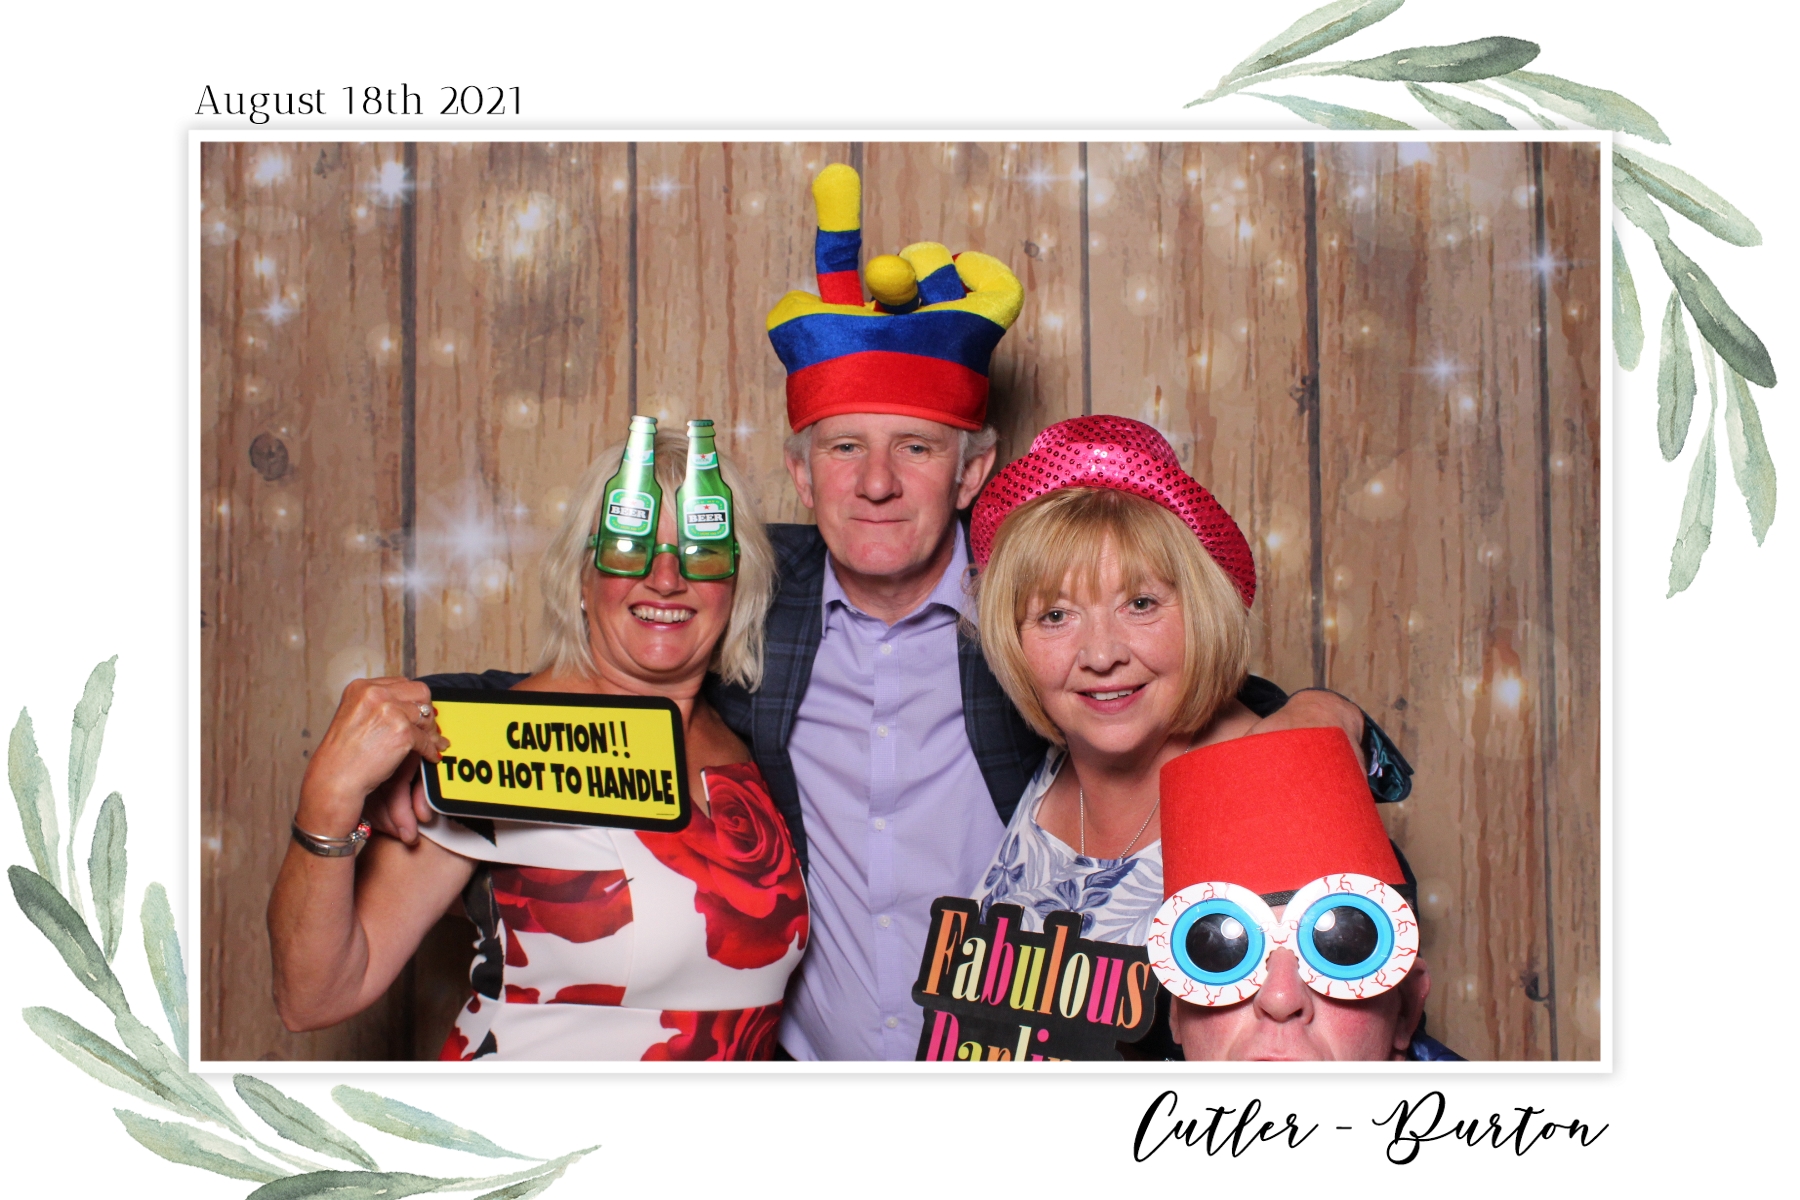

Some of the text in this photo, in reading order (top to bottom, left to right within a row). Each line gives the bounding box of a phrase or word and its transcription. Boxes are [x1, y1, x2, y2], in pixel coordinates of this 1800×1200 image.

[611, 505, 647, 519] BEER
[688, 513, 724, 523] BEER
[506, 720, 631, 759] CAUTION!!
[442, 755, 676, 806] TOO HOT TO HANDLE
[922, 908, 1151, 1029] Fabulous
